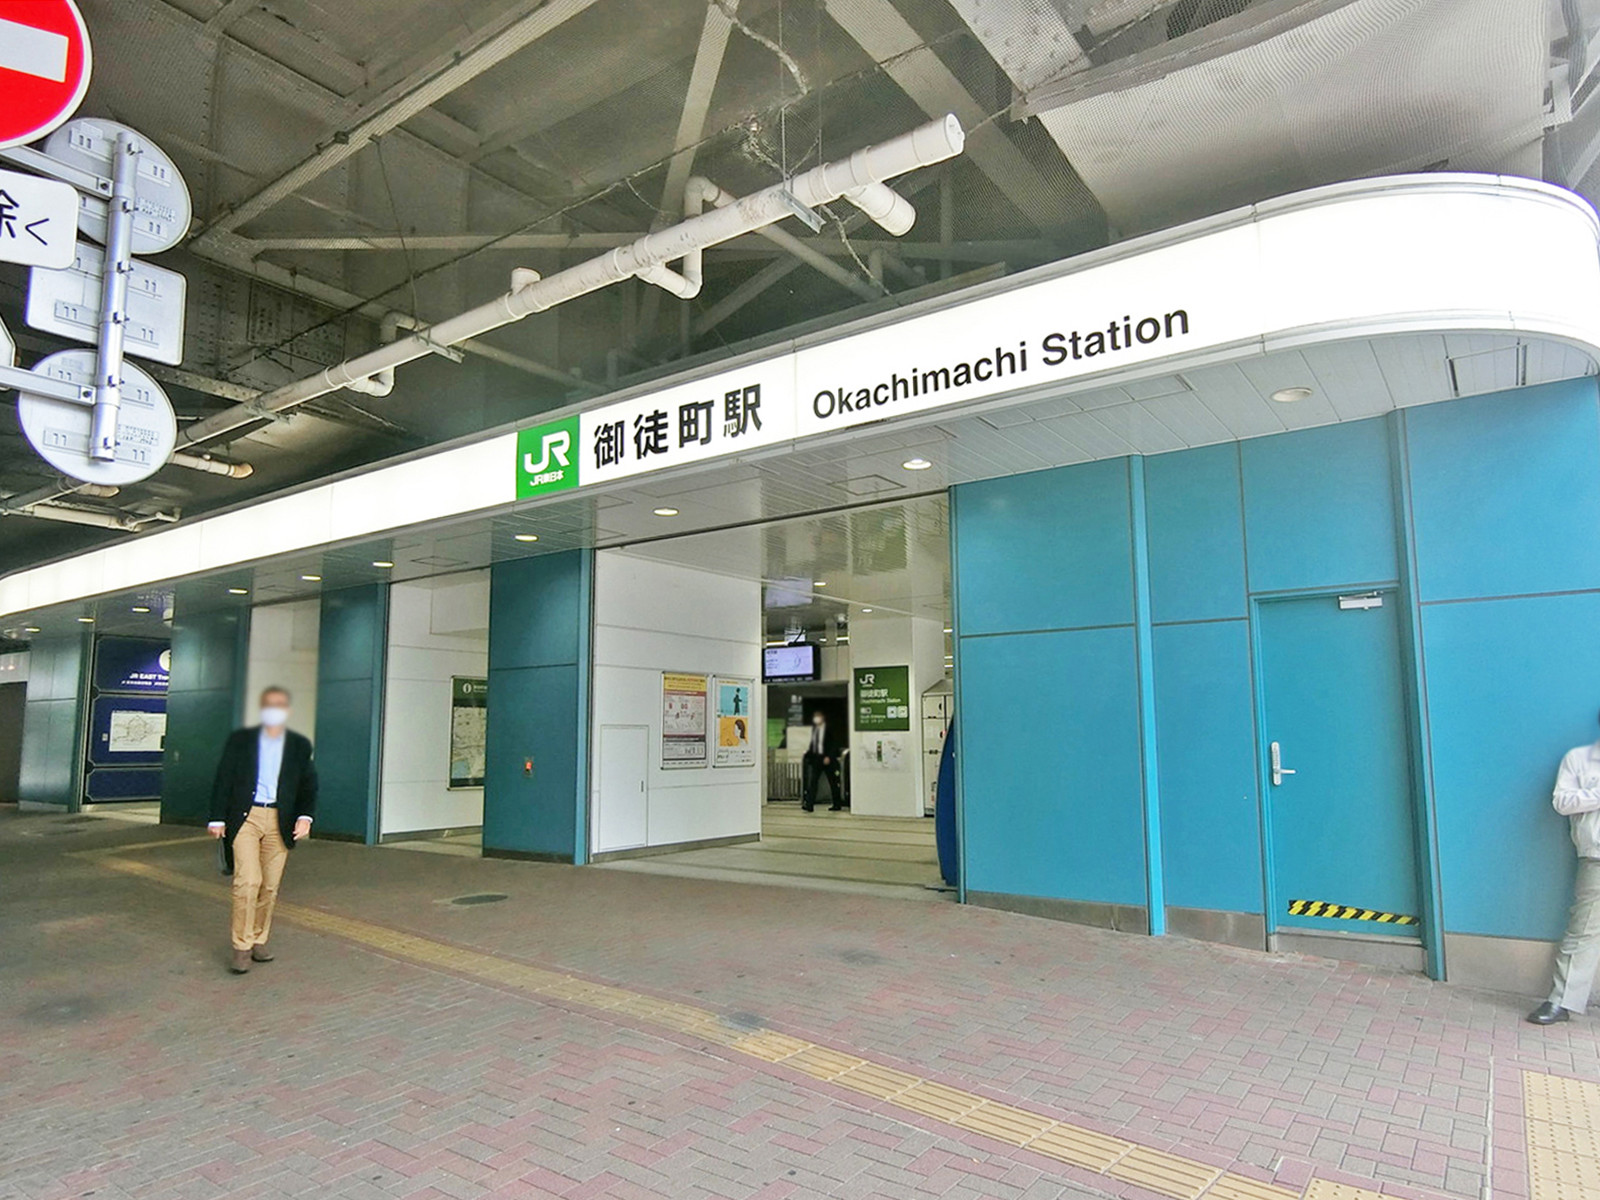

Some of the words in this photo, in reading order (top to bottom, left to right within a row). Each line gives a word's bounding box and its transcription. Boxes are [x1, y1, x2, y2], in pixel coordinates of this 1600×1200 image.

[813, 340, 1028, 419] Okachimachi
[1042, 309, 1189, 367] Station
[524, 430, 571, 474] JR
[594, 384, 762, 469] 御徒町駅
[859, 673, 875, 684] JR
